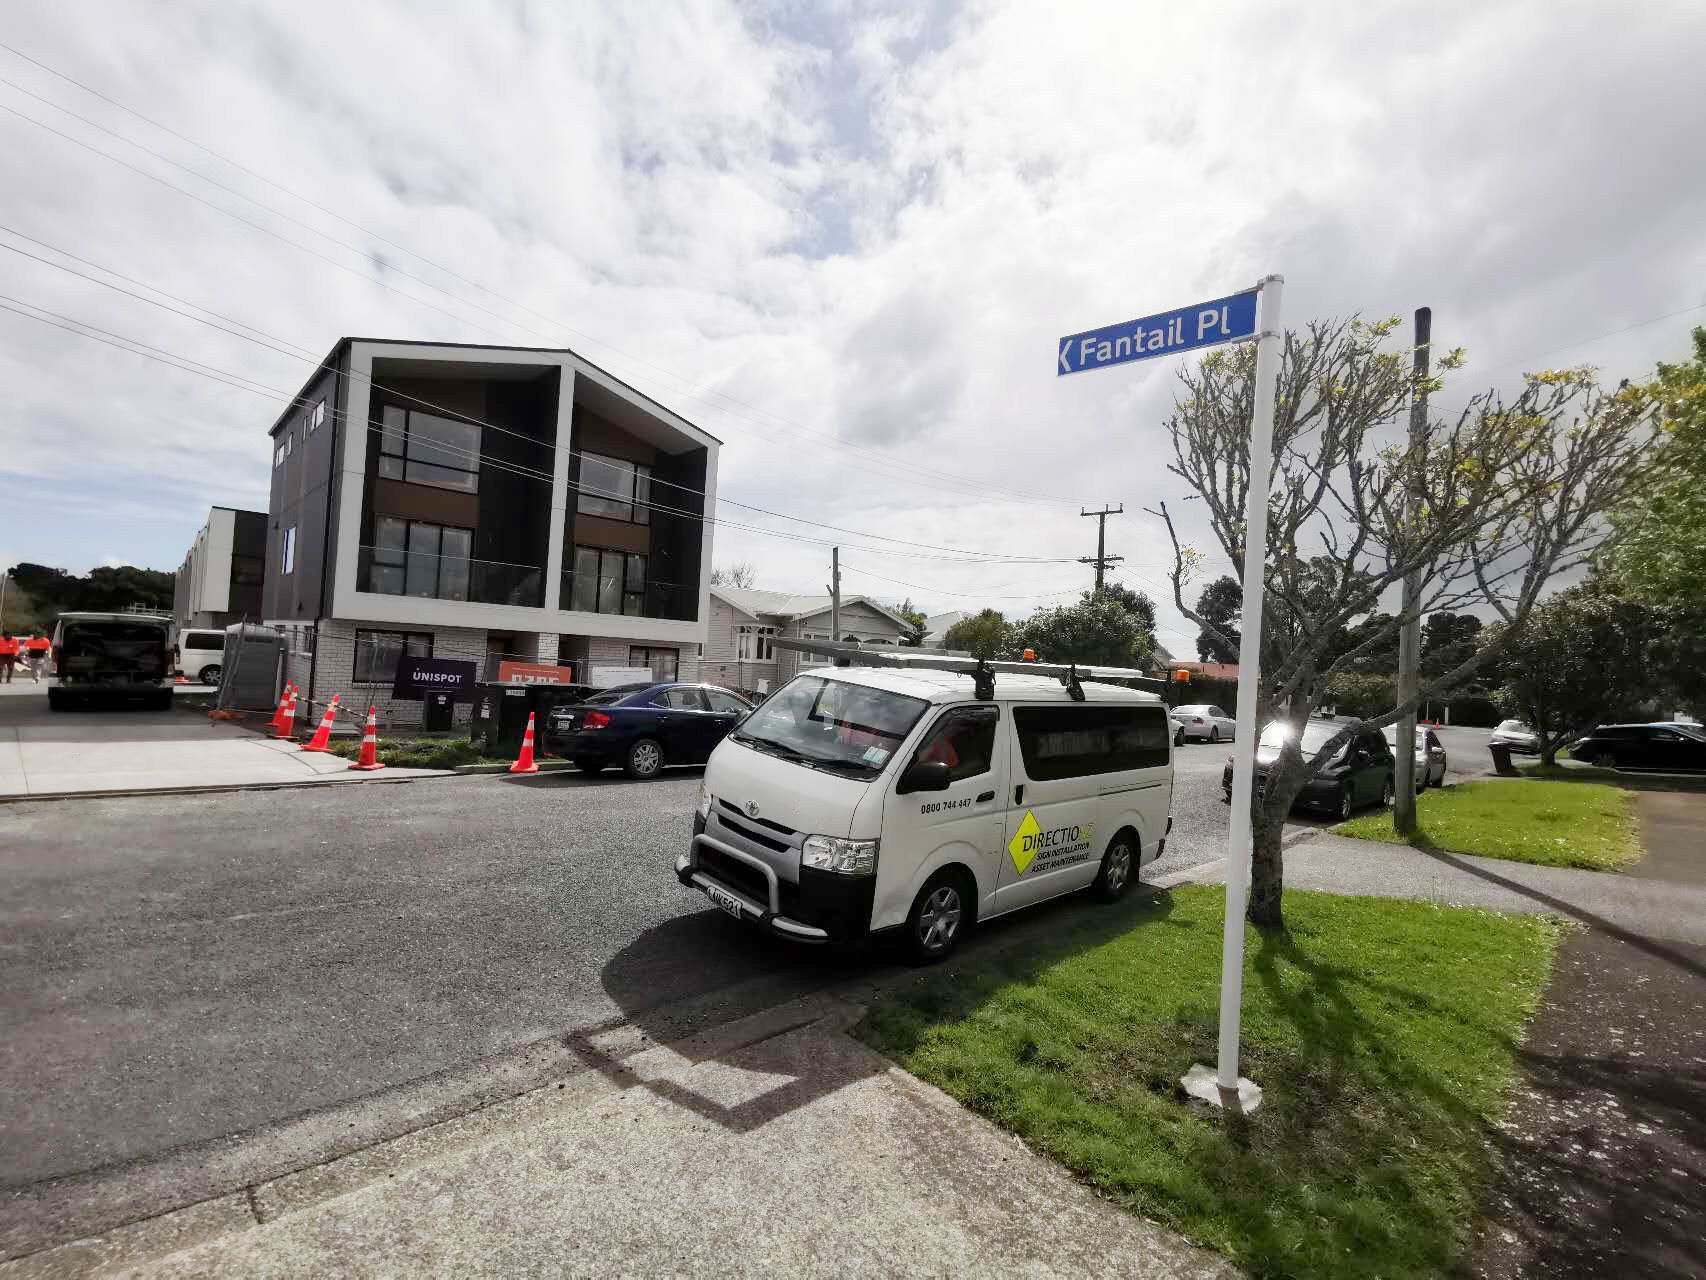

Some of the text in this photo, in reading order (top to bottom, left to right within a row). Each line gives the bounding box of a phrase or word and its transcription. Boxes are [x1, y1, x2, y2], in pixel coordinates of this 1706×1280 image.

[1080, 306, 1231, 366] Fantail Pl
[413, 669, 463, 684] UNISPOT
[921, 798, 972, 815] 0800 744 447
[1037, 842, 1090, 861] SIGN INSTALLATION
[1031, 852, 1089, 873] ASSET MAINTENANCE
